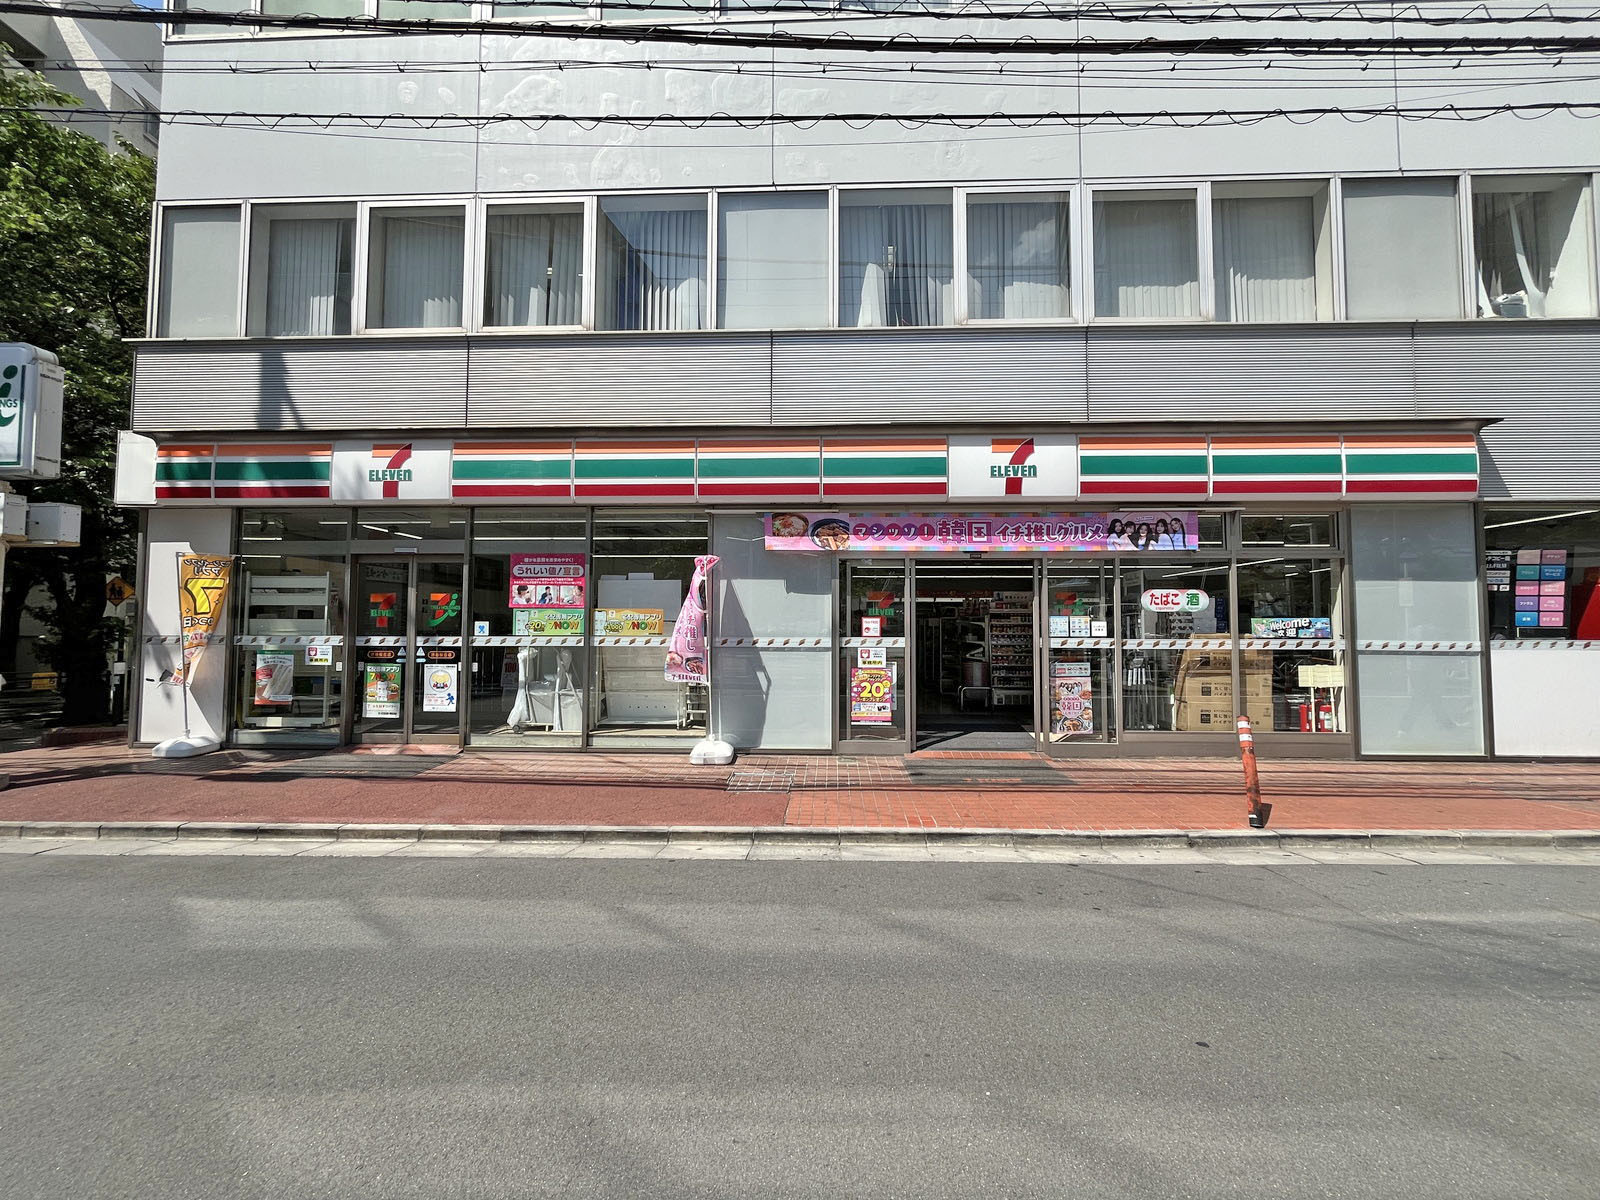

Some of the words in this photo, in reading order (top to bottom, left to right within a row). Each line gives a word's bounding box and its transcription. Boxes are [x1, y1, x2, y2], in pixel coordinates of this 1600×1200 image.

[936, 519, 992, 545] 韓国
[996, 521, 1104, 543] イチ推しグルメ
[1149, 593, 1181, 606] たばこ
[1186, 593, 1200, 606] 酒
[550, 621, 579, 630] 7NOW
[626, 621, 657, 630] 7NOW
[1270, 618, 1311, 631] Welcome
[859, 681, 885, 698] 20
